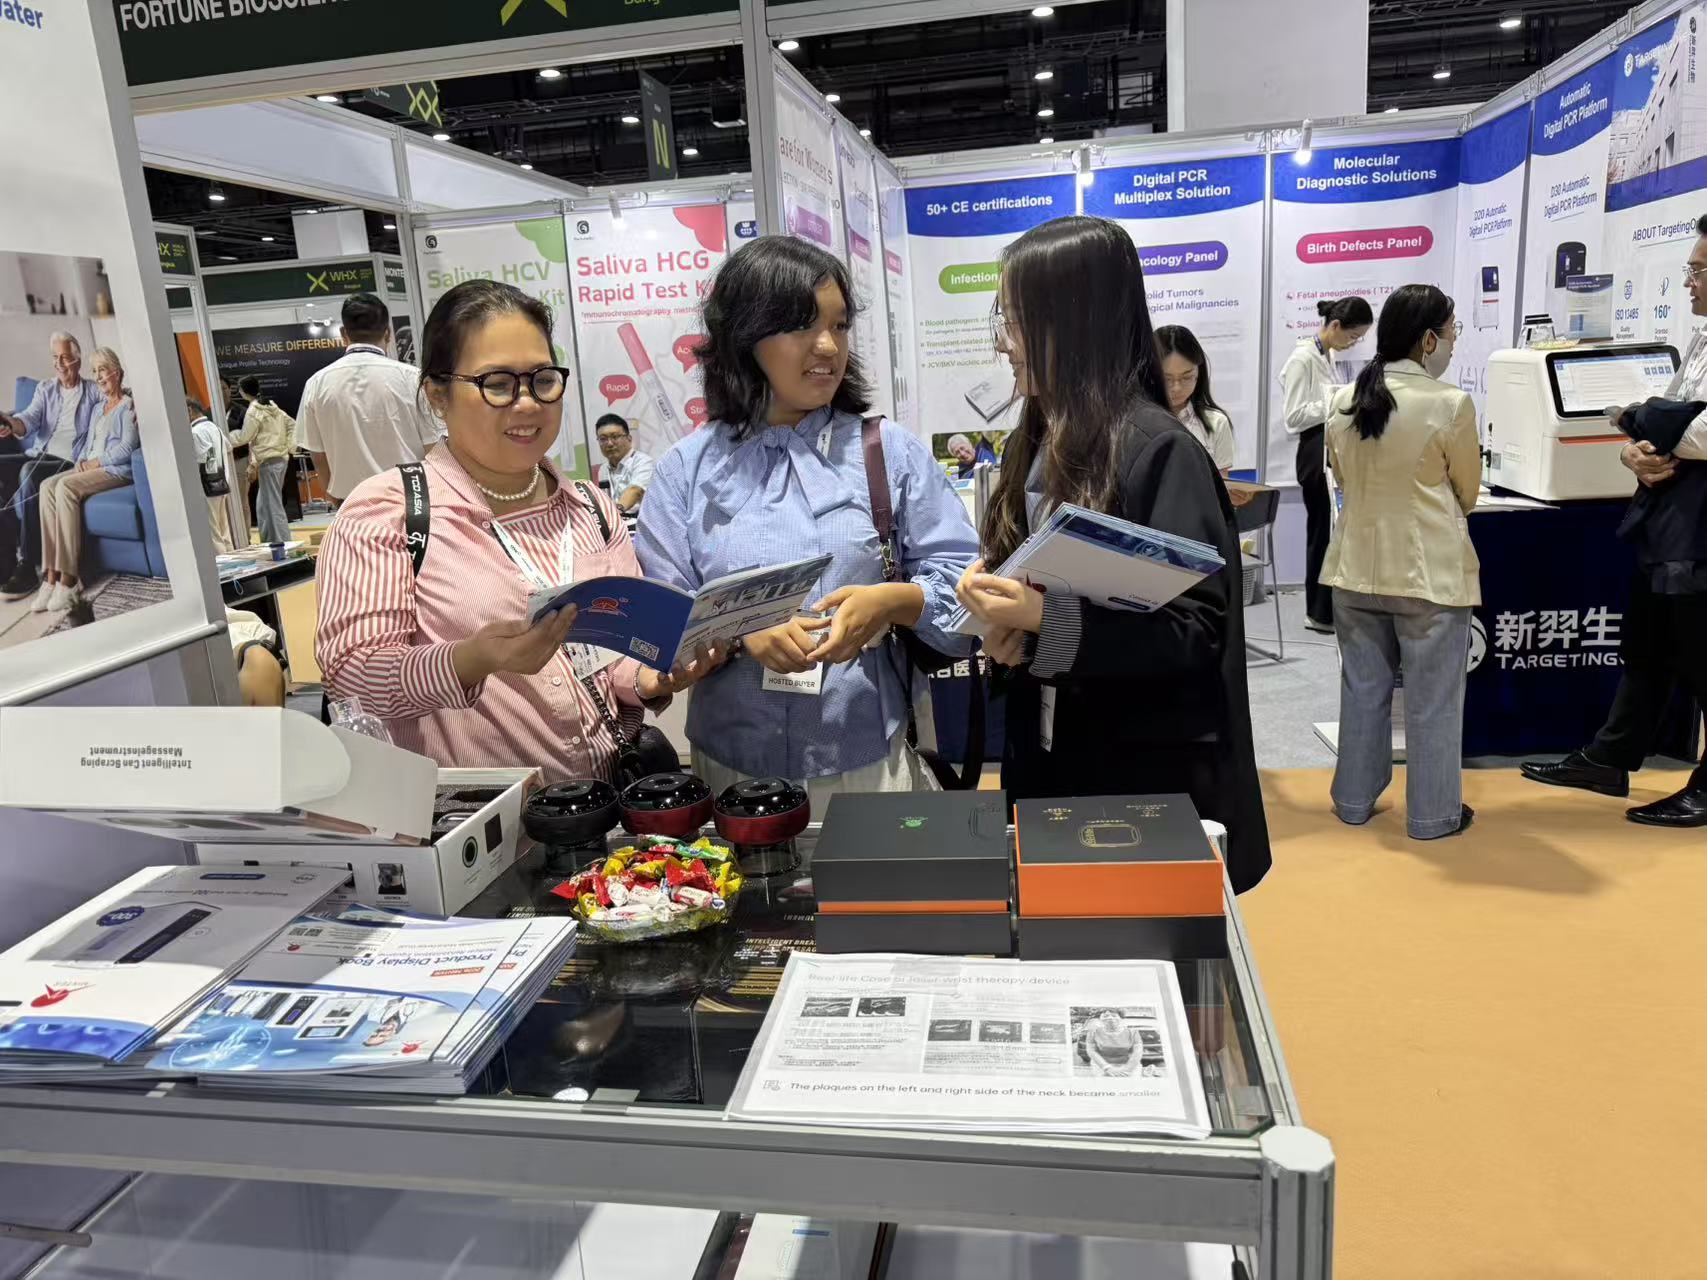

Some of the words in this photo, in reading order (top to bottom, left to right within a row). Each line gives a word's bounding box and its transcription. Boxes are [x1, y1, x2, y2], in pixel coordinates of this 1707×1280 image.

[120, 0, 225, 31] FORTUNE
[1560, 81, 1591, 109] Automatic
[1544, 118, 1563, 139] Digital
[1563, 111, 1579, 130] PCR
[1578, 97, 1608, 121] Platform
[1334, 154, 1400, 170] Molecular
[1134, 172, 1175, 187] Digital
[1179, 169, 1207, 182] PCR
[1296, 173, 1368, 190] Diagnostic
[1372, 169, 1437, 183] Solutions
[1561, 175, 1590, 195] Automatic
[1114, 190, 1173, 205] Multiplex
[1176, 185, 1231, 199] Solution
[927, 204, 948, 216] 50+
[951, 201, 969, 214] CE
[972, 195, 1053, 212] certifications
[1485, 203, 1508, 218] Automatic
[1544, 203, 1559, 218] Digital
[1559, 199, 1571, 213] PCR
[1572, 192, 1597, 210] Platform
[1632, 227, 1657, 242] ABOUT
[1307, 241, 1337, 254] Birth
[1340, 239, 1383, 252] Defects
[1387, 236, 1422, 249] Panel
[577, 253, 647, 276] Saliva
[657, 250, 710, 272] HCG
[1186, 251, 1218, 263] Panel
[329, 270, 358, 282] WHX
[501, 261, 551, 283] HCV
[578, 283, 634, 305] Rapid
[641, 282, 688, 300] Test
[1166, 288, 1204, 299] Tumors
[1297, 290, 1318, 299] Fetal
[1175, 299, 1239, 311] Malignancies
[234, 341, 285, 354] MEASURE
[606, 383, 630, 393] Rapid
[413, 492, 422, 516] ASIA
[1495, 606, 1623, 650] 新羿生
[1495, 652, 1625, 669] TARGETING
[768, 677, 794, 686] HOSTED
[794, 679, 816, 688] BUYER
[80, 757, 122, 769] Scraping
[122, 758, 140, 770] Can
[141, 757, 192, 770] Intelligent
[336, 957, 373, 967] Book
[376, 957, 431, 969] Display
[432, 953, 493, 966] Product
[976, 976, 1026, 986] therapy
[1029, 977, 1071, 985] device
[790, 1083, 810, 1091] The
[812, 1083, 858, 1093] plaques
[860, 1084, 875, 1092] on
[878, 1084, 896, 1092] the
[899, 1084, 918, 1093] left
[920, 1086, 943, 1094] and
[945, 1086, 972, 1096] right
[974, 1087, 1000, 1096] side
[1001, 1087, 1015, 1096] of
[1017, 1087, 1036, 1096] the
[1038, 1088, 1067, 1097] neck
[1069, 1089, 1117, 1098] became
